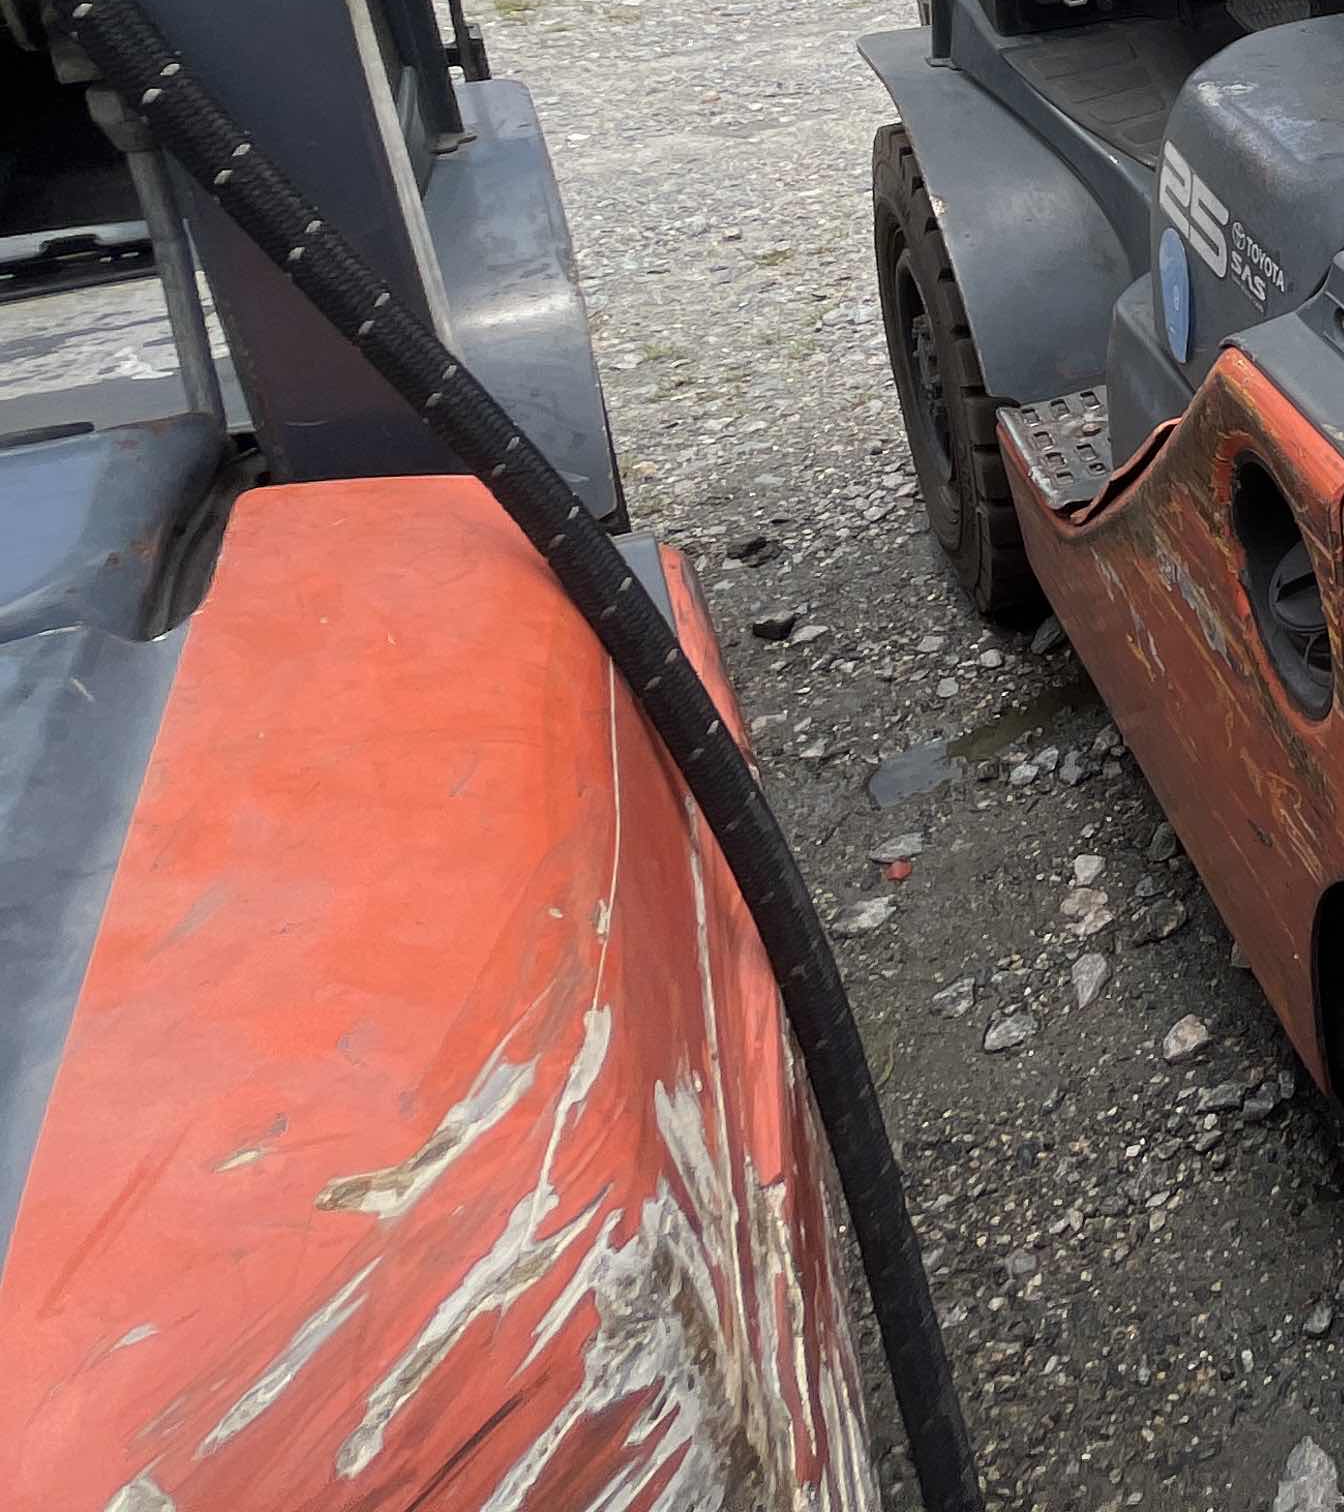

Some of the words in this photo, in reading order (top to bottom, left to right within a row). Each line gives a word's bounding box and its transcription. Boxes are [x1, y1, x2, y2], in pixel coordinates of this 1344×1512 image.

[1159, 140, 1229, 278] 25
[1231, 250, 1266, 301] SAS
[1246, 236, 1285, 293] TOYOTA
